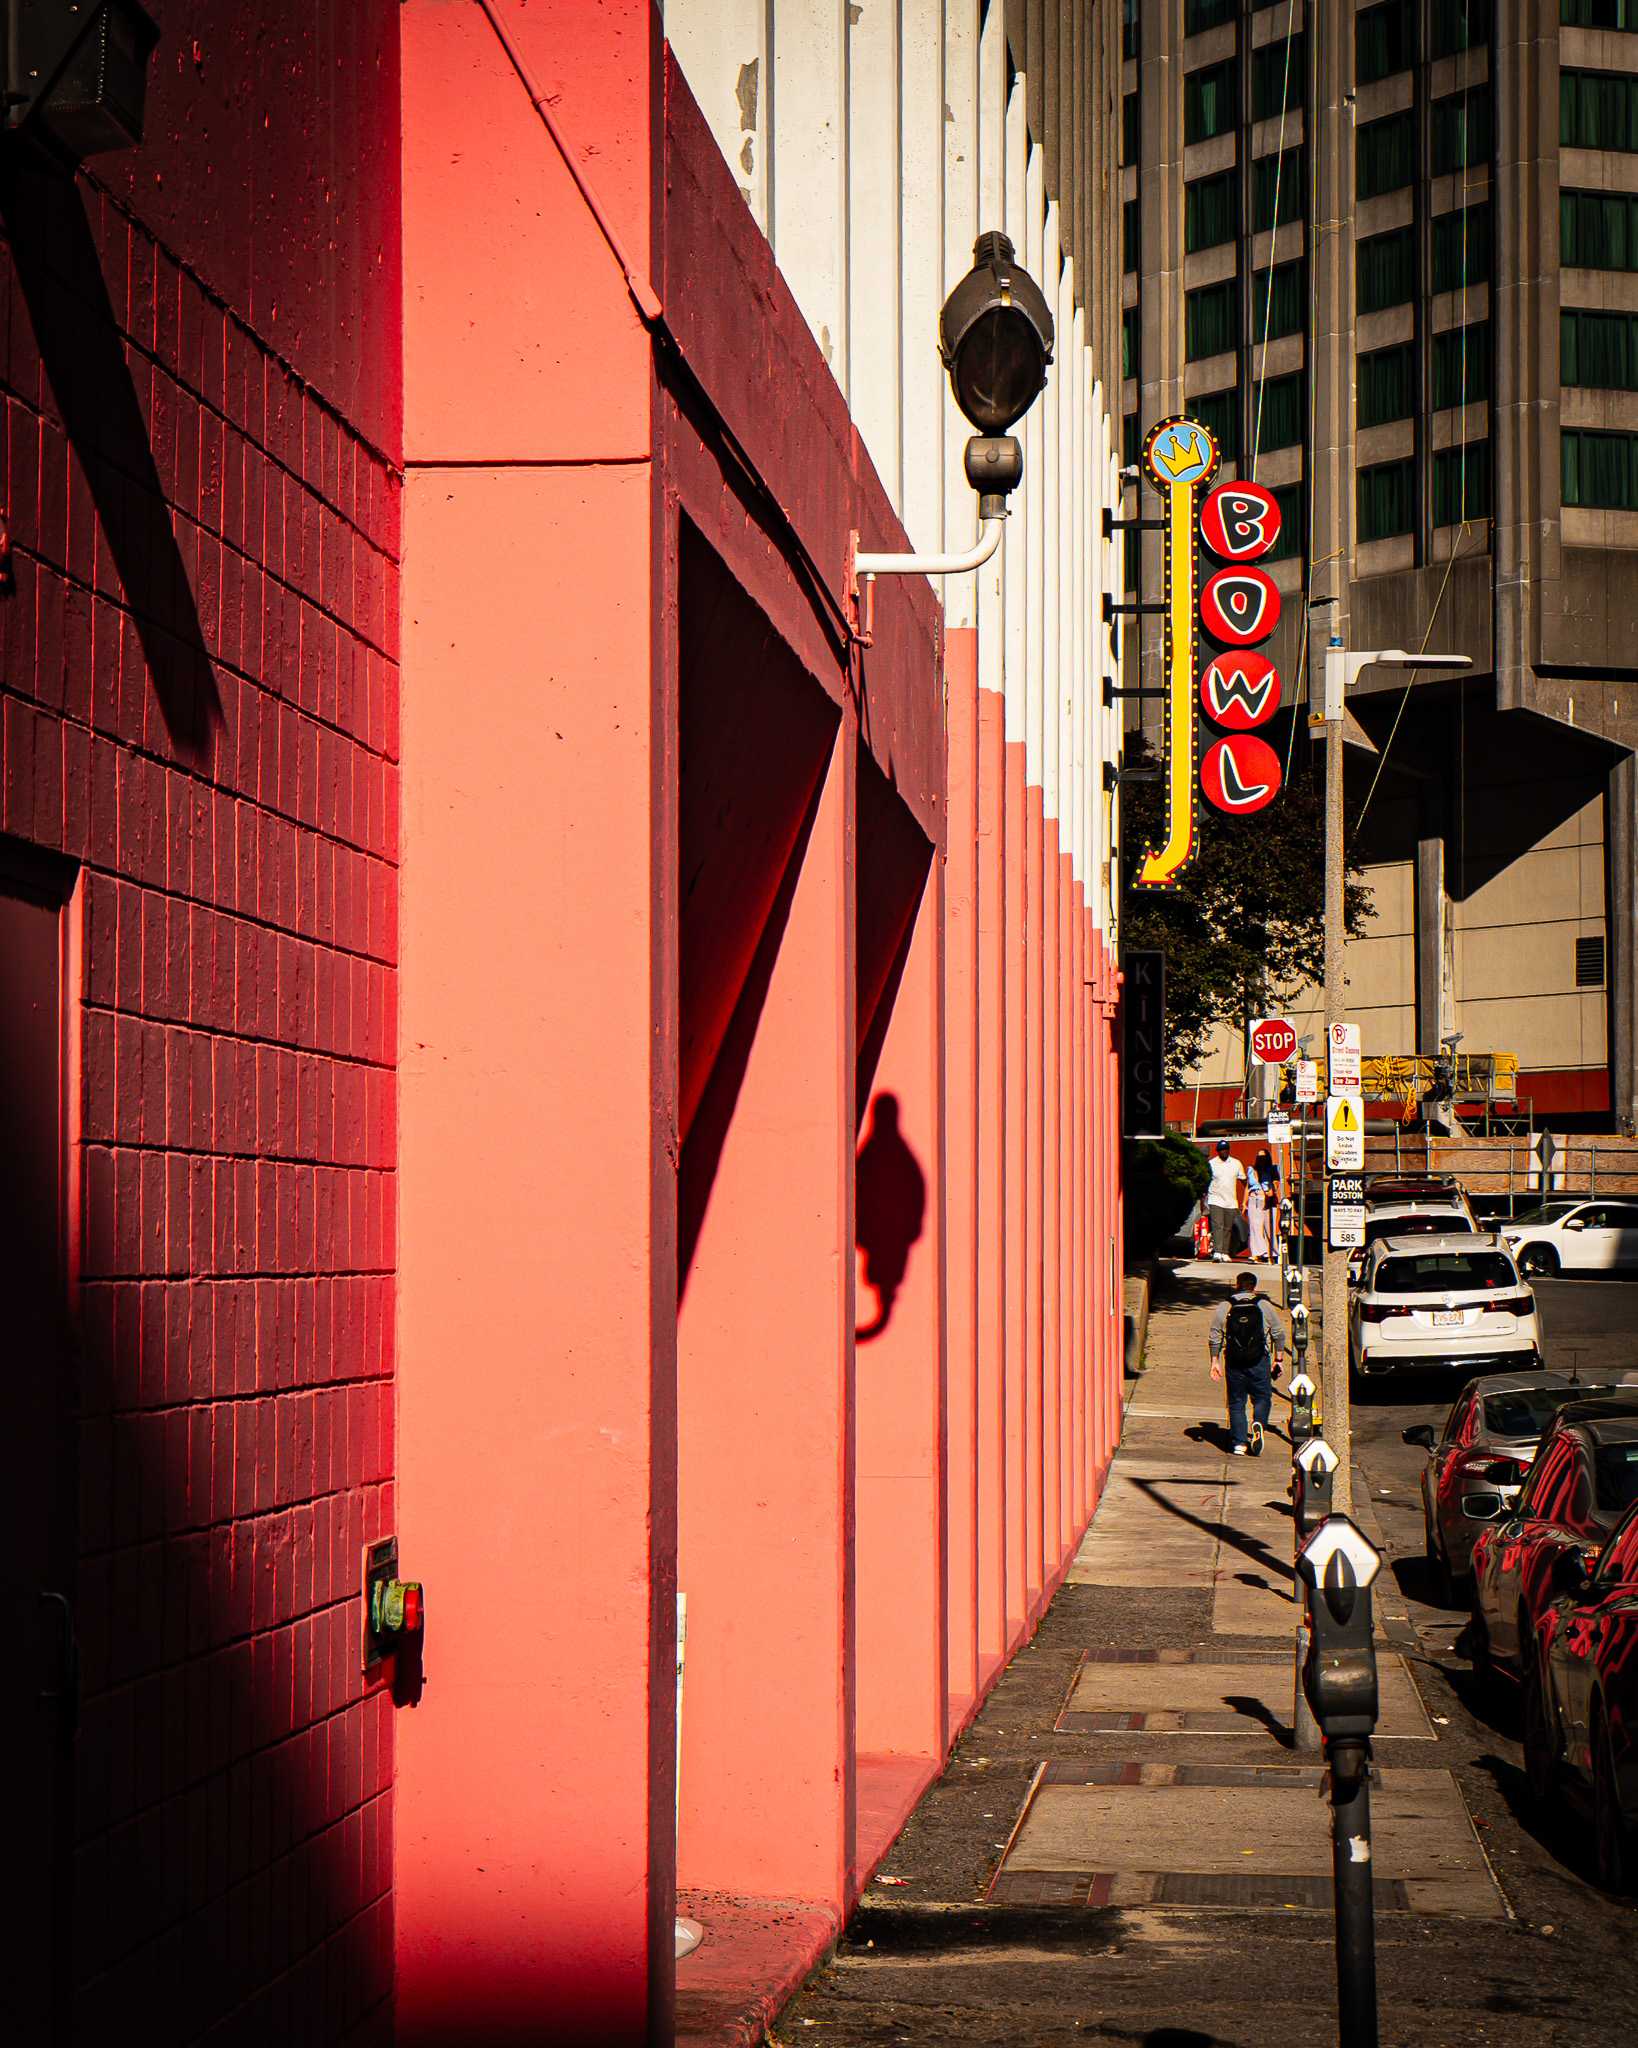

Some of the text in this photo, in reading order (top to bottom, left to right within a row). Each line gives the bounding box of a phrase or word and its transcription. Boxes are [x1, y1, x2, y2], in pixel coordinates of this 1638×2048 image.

[1208, 491, 1276, 806] BOWL
[1133, 961, 1154, 1115] KINGS
[1254, 1032, 1294, 1051] STOP
[1332, 1179, 1363, 1191] PARK
[1332, 1191, 1363, 1200] BOSTON
[1340, 1234, 1356, 1242] 585
